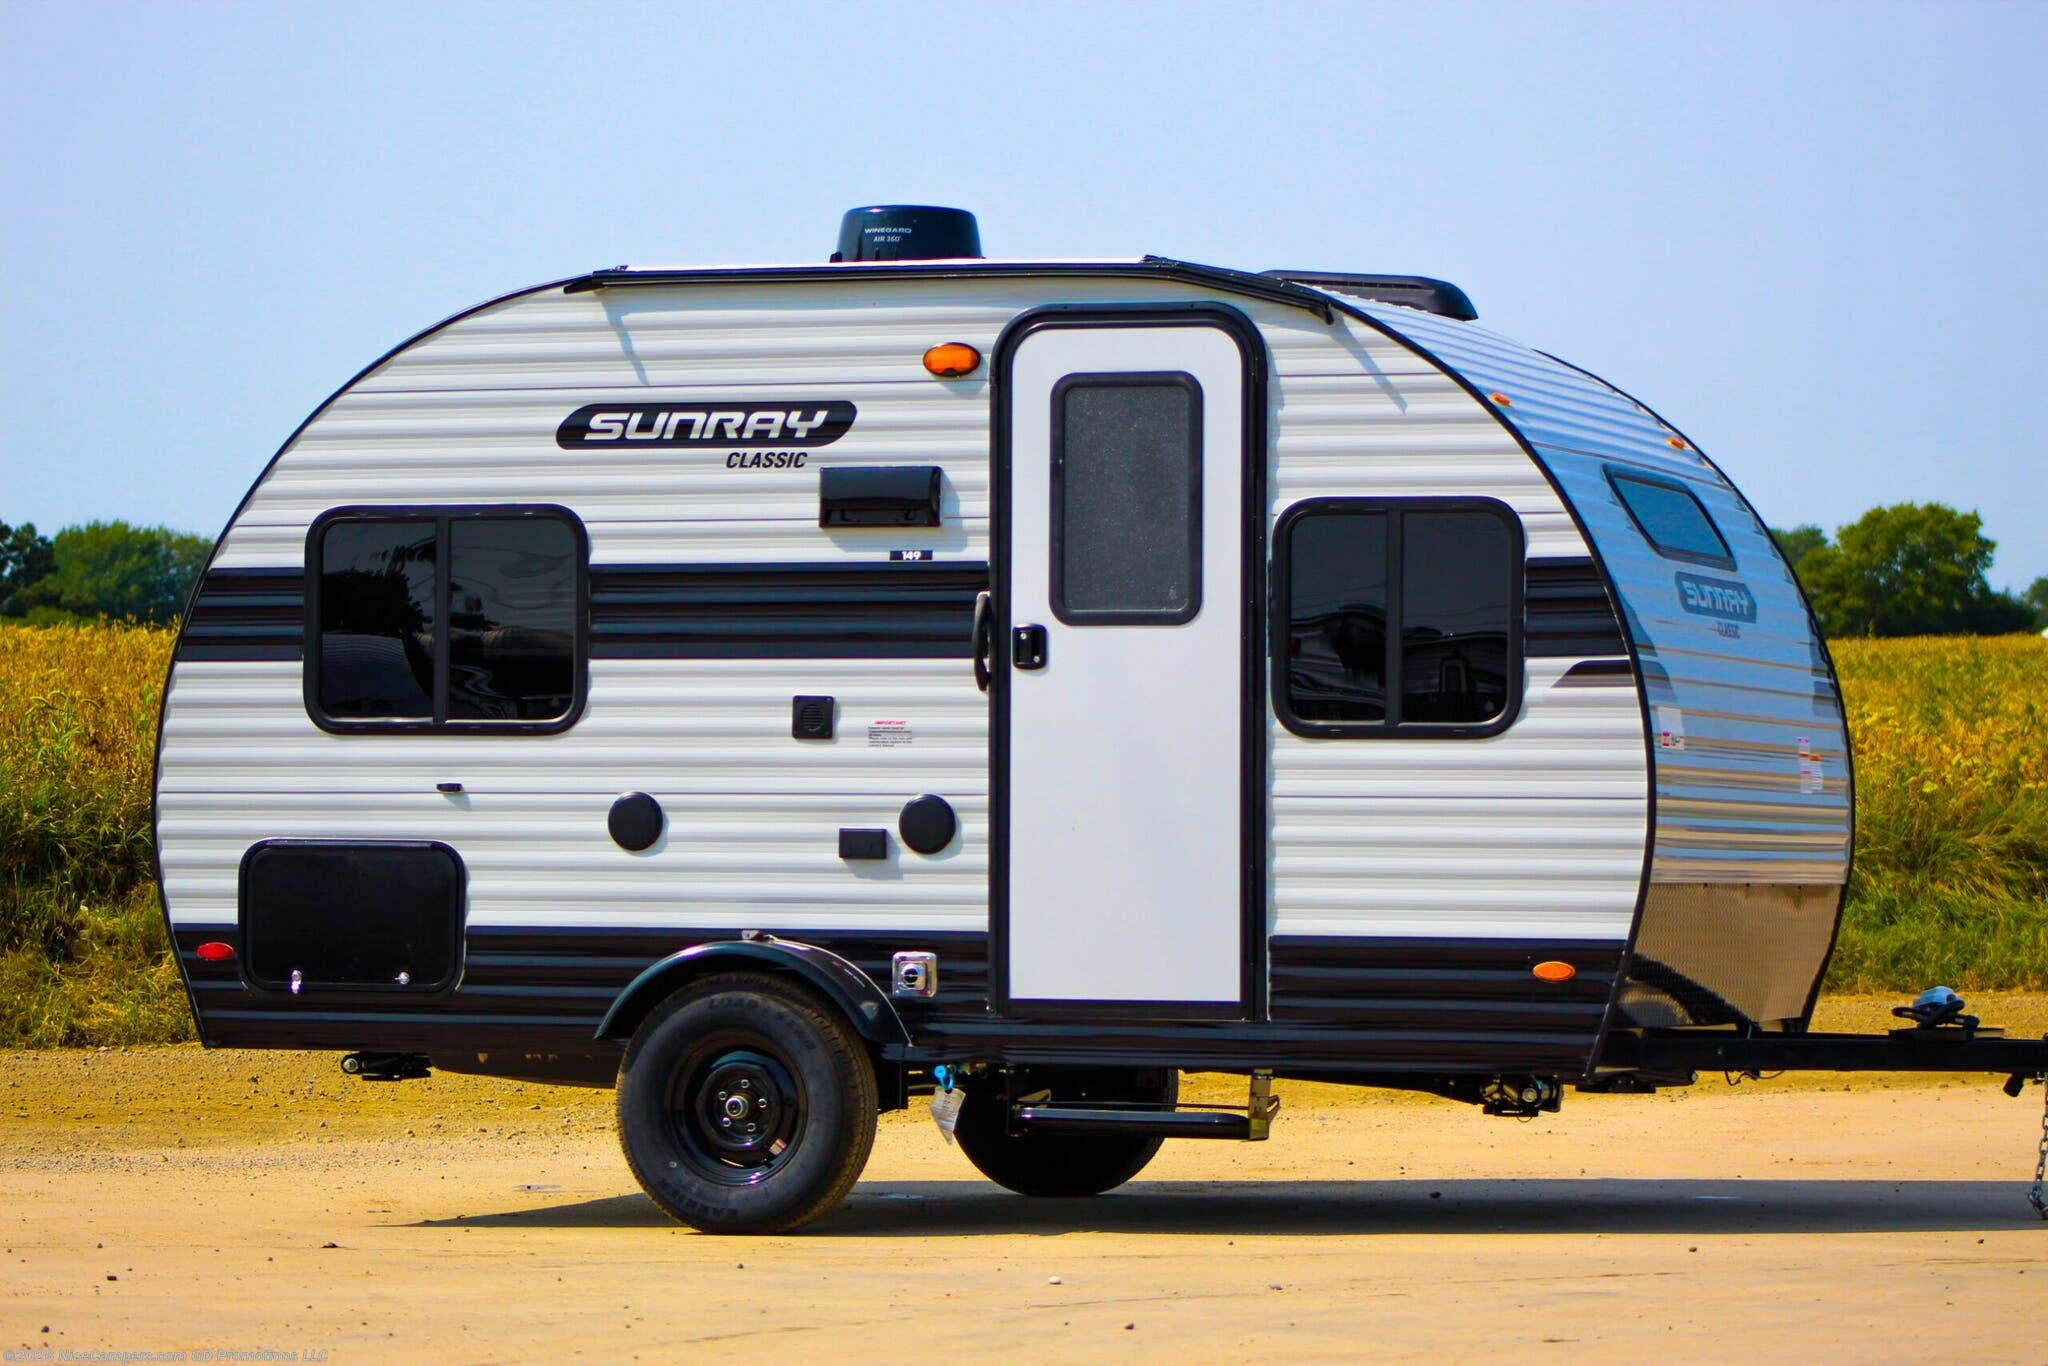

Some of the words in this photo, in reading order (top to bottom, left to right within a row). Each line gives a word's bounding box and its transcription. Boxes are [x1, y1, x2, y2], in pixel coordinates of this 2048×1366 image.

[584, 410, 829, 441] SUNRAY
[726, 451, 808, 469] CLASSIC
[901, 550, 922, 560] 149
[1681, 580, 1749, 616] SUNRAY
